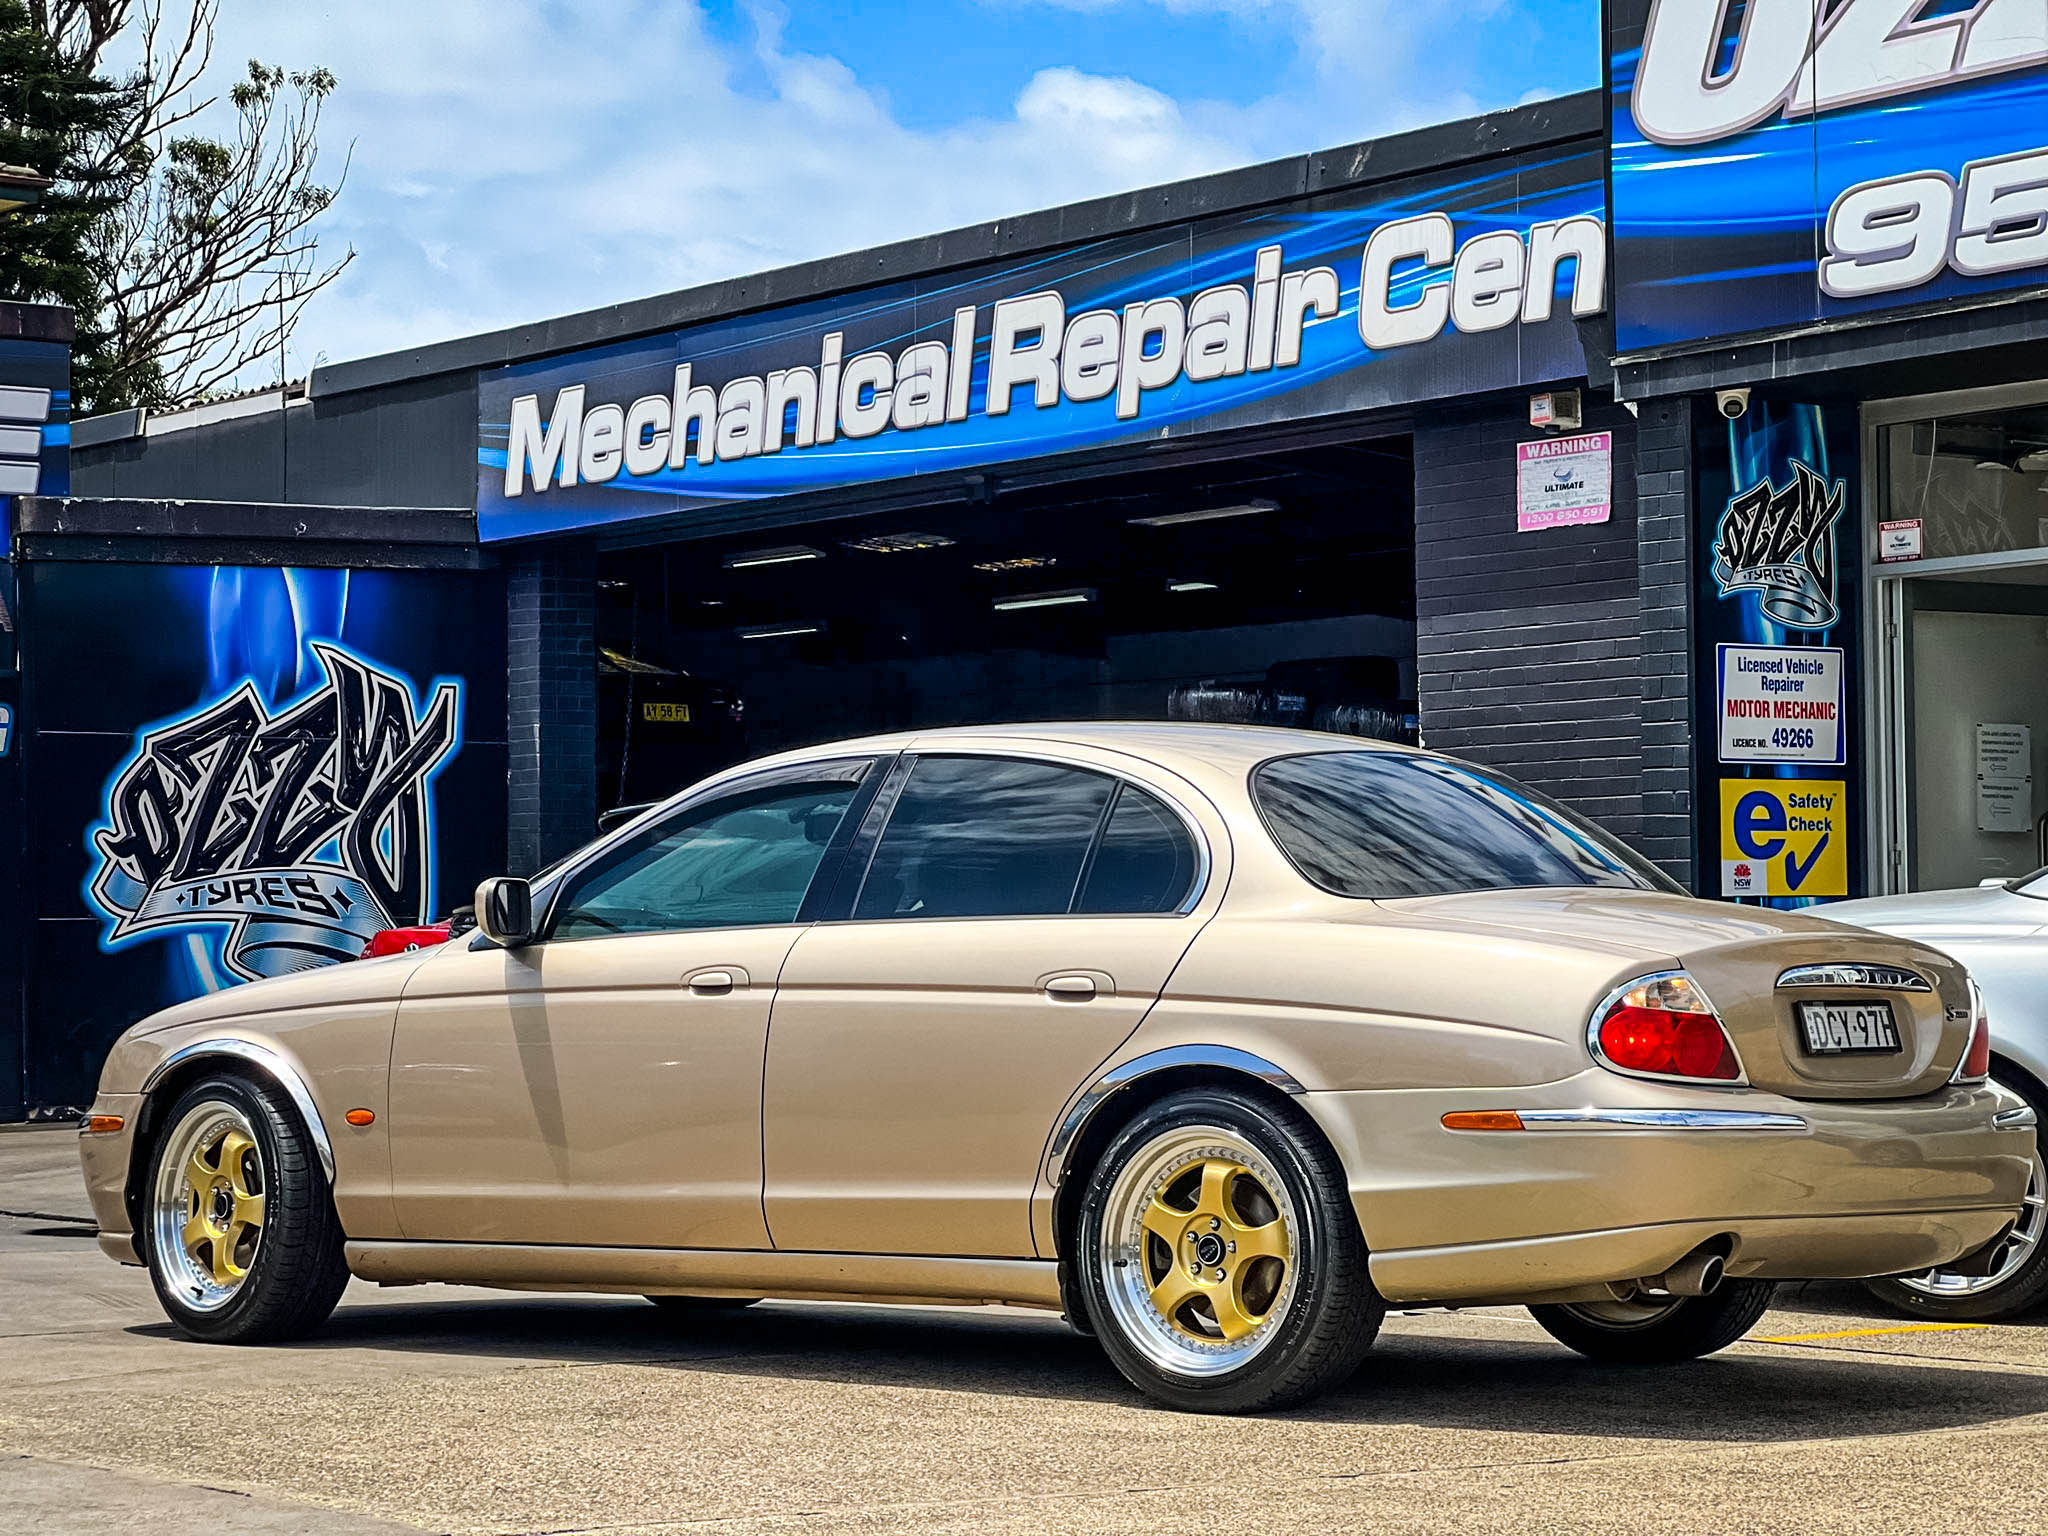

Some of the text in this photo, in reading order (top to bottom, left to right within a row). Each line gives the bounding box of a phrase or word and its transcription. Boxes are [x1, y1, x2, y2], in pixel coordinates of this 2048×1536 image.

[503, 304, 977, 498] Mechanical
[985, 243, 1340, 420] Repair
[1526, 437, 1602, 458] WARNING
[1544, 480, 1584, 493] ULTIMATE
[1883, 520, 1918, 530] WARNING
[1747, 567, 1805, 590] TYRES
[1737, 656, 1824, 675] Licensed Vehicle
[1761, 675, 1804, 694] Repairer
[1727, 699, 1836, 720] MOTOR MECHANIC
[1732, 738, 1757, 748] LICENCE
[1772, 728, 1814, 749] 49266
[1788, 793, 1833, 811] Safety
[1733, 790, 1787, 860] e
[1788, 816, 1833, 832] Check
[1734, 878, 1752, 887] NSW
[184, 874, 340, 920] TYRES
